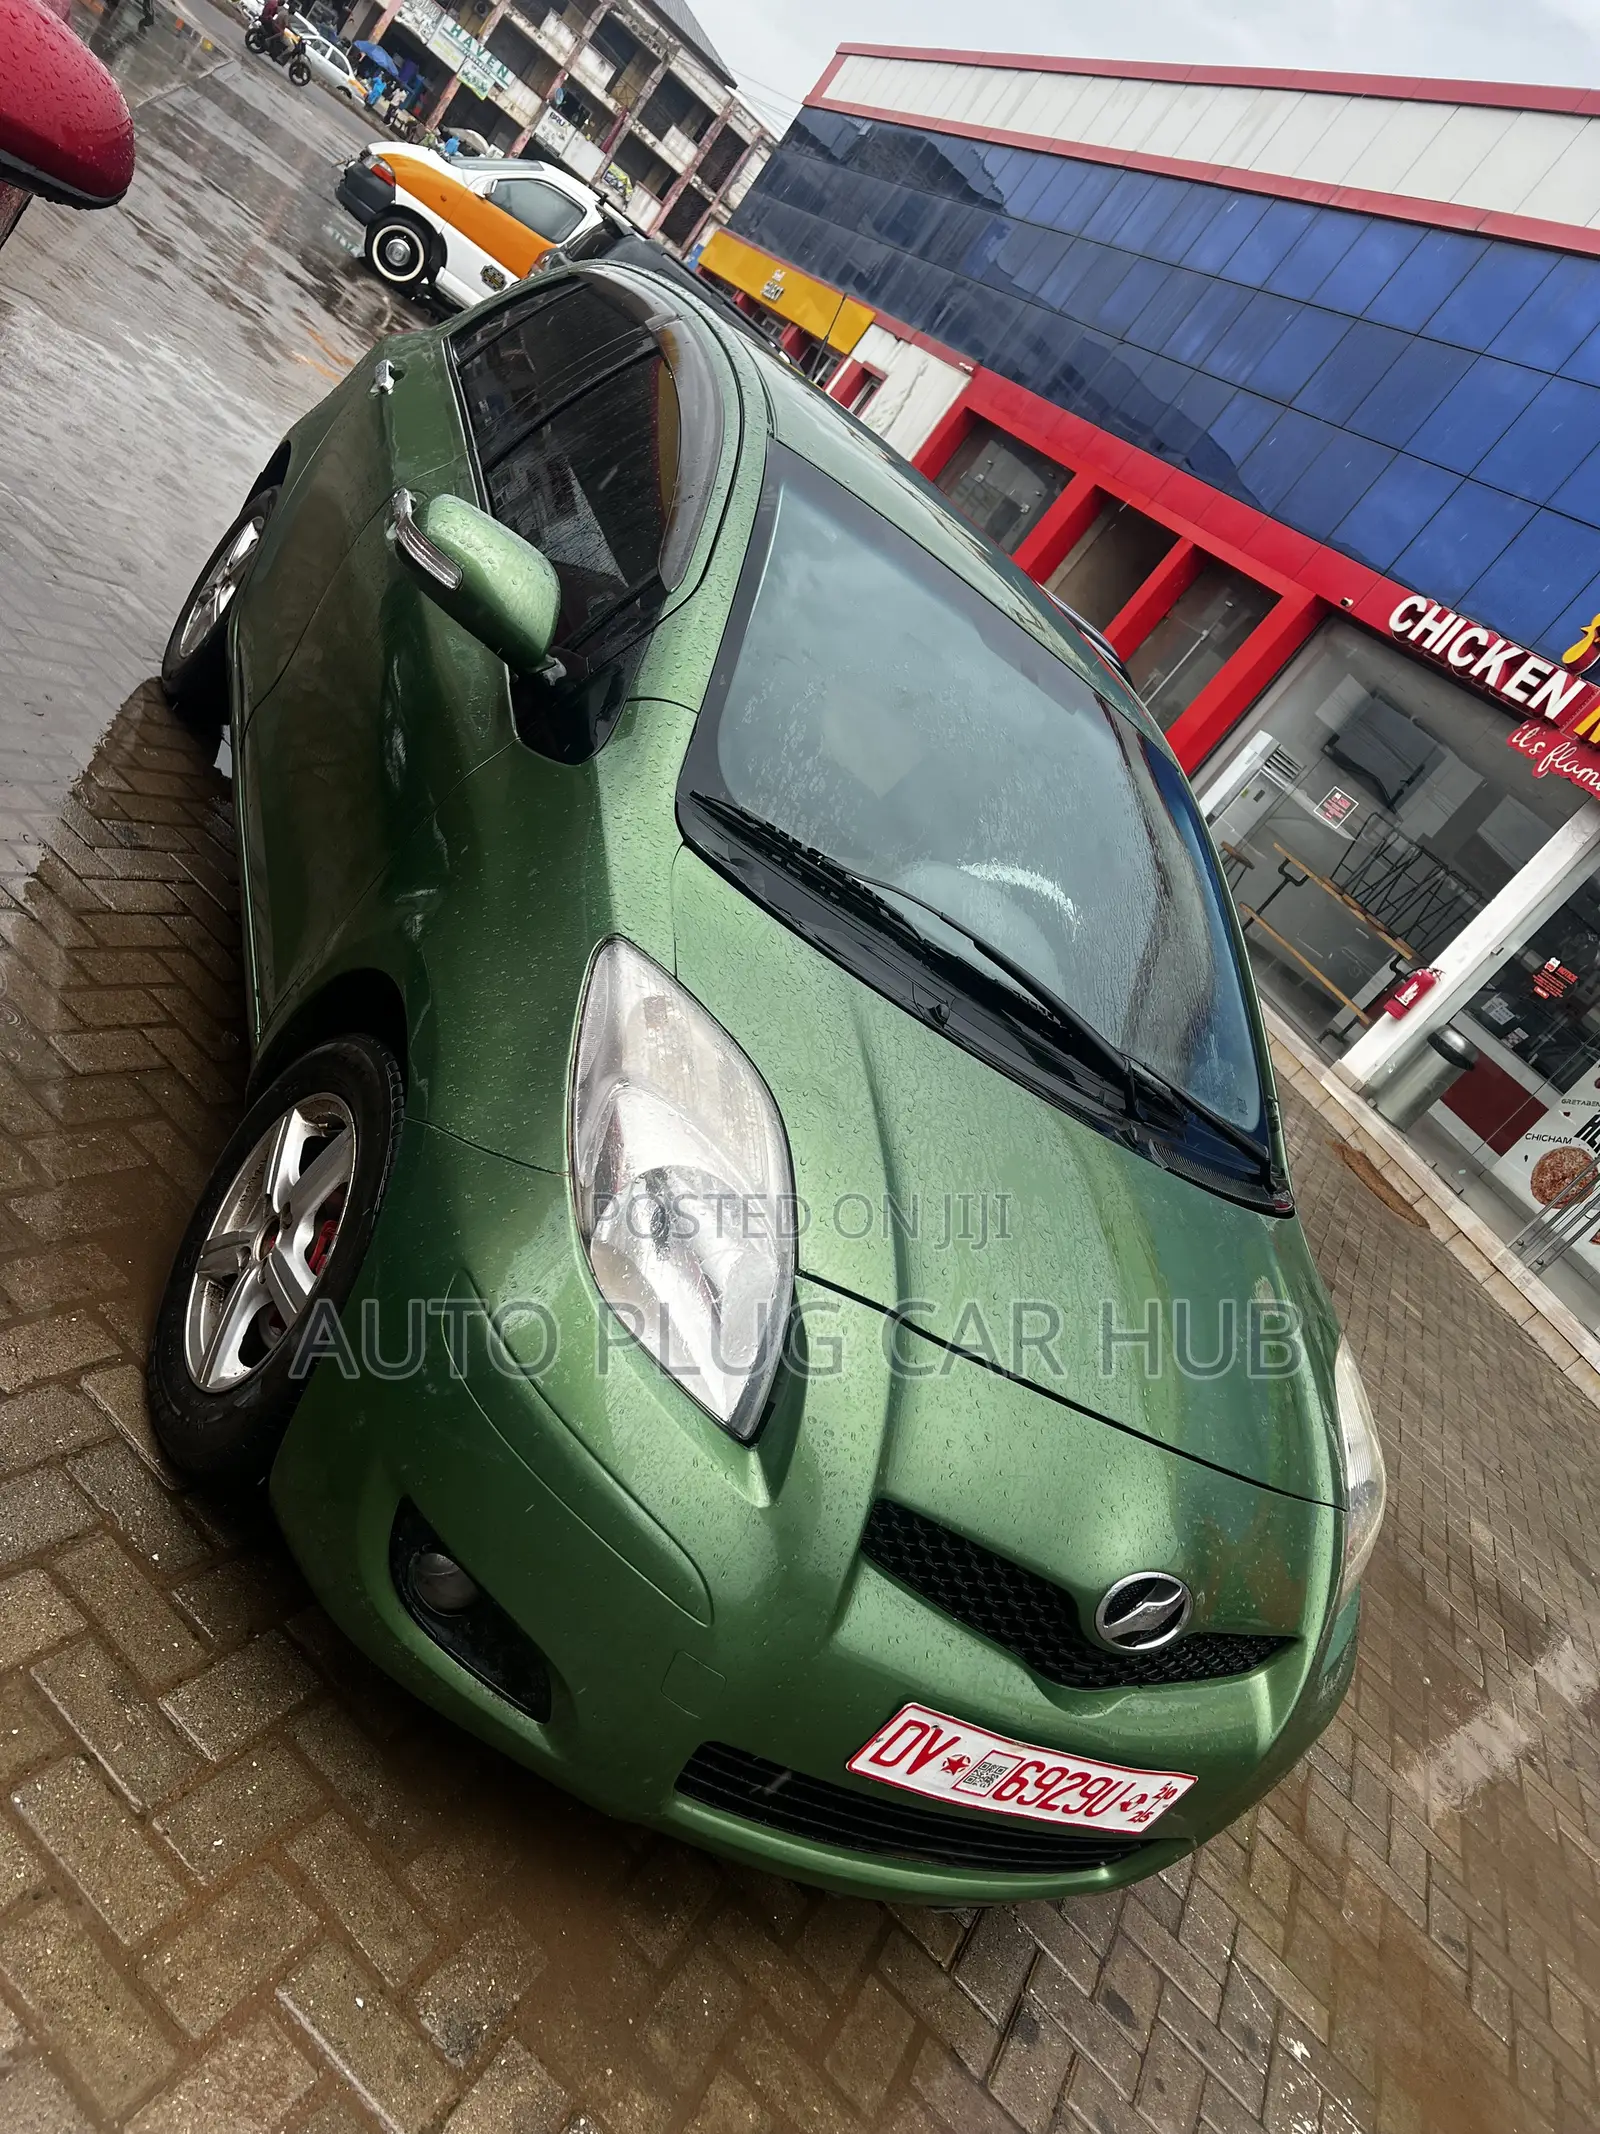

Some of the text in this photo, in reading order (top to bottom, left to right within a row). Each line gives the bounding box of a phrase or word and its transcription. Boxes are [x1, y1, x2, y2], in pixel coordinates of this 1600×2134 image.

[450, 23, 510, 79] HAVEN
[1388, 595, 1587, 720] CHICKEN
[1537, 741, 1600, 791] flam
[1557, 965, 1579, 984] NOTICE
[1524, 1132, 1573, 1145] CHICHAM
[868, 1718, 1137, 1817] DV 6929U
